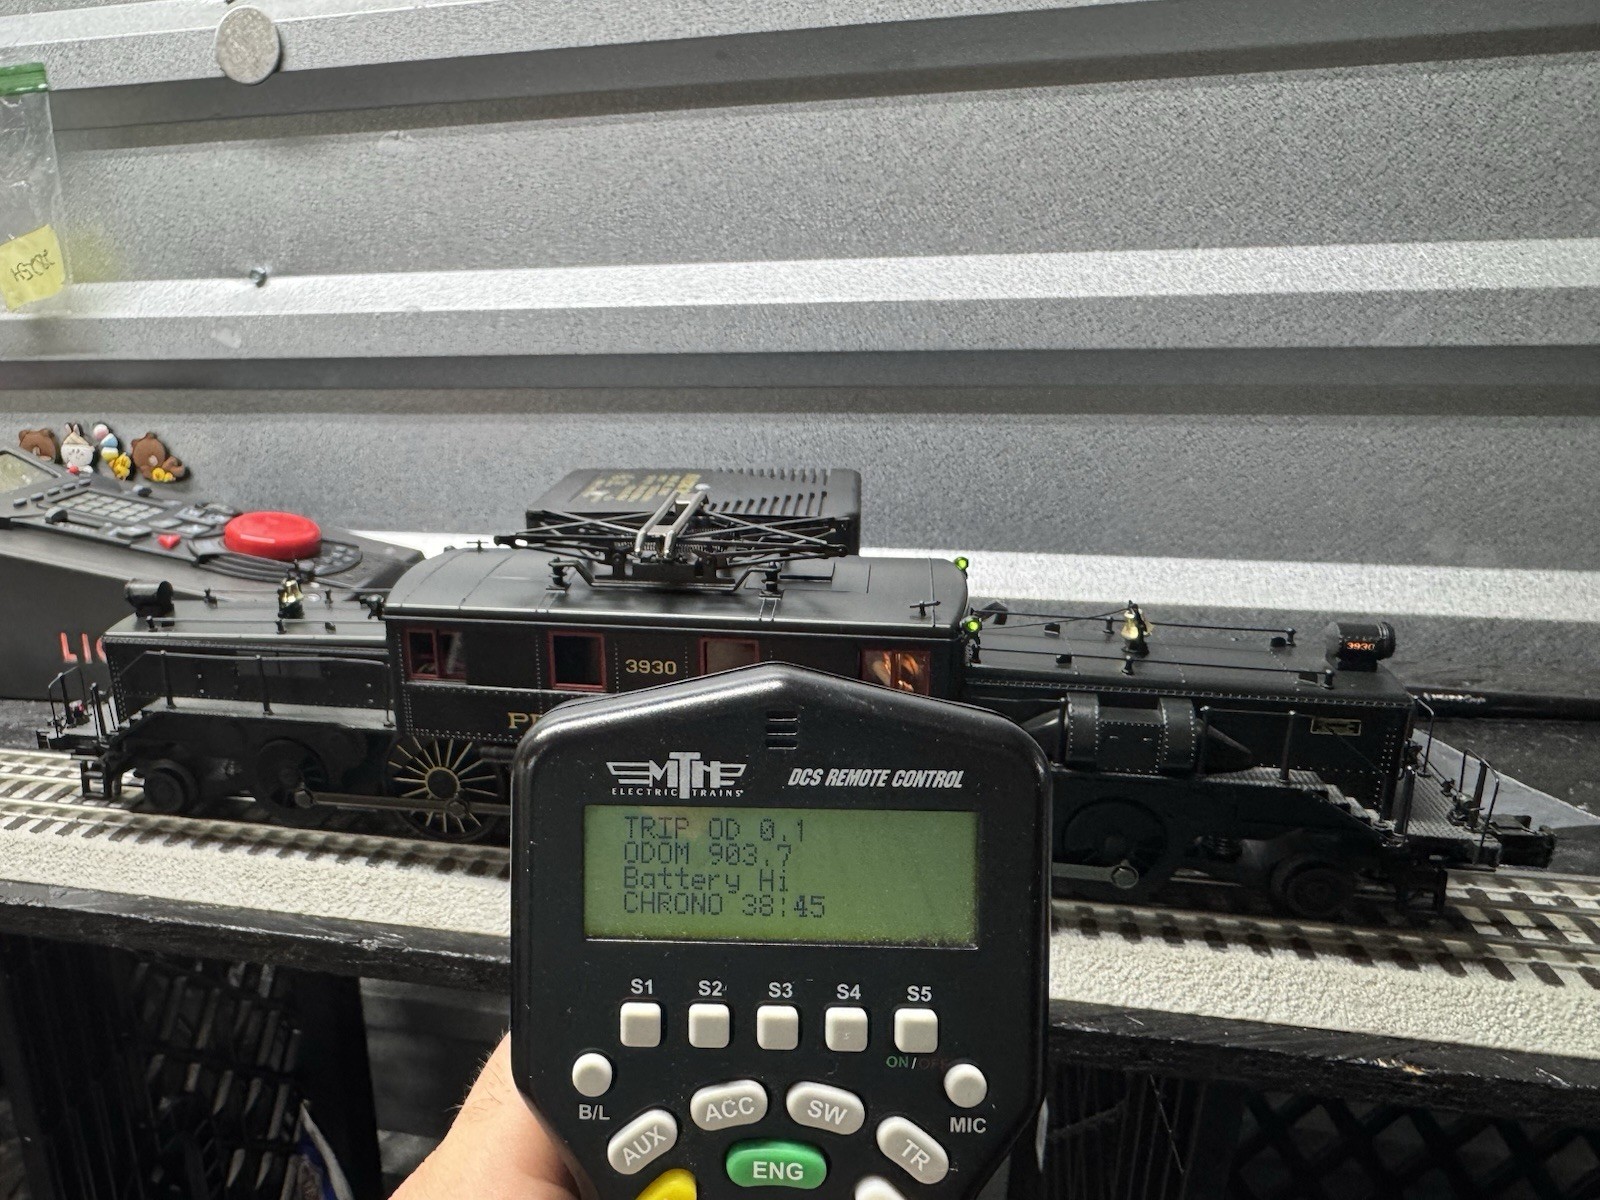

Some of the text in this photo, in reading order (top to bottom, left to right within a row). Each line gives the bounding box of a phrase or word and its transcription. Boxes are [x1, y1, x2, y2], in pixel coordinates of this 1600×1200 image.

[1346, 641, 1375, 651] 3930
[625, 659, 677, 675] 3930
[649, 751, 721, 799] MTH
[788, 768, 964, 788] DCS REMOTE CONTROL
[611, 787, 678, 797] ELECTRIC
[624, 816, 804, 842] TRIP OD 0.1
[624, 841, 792, 867] ODOM 903.7
[624, 866, 789, 894] Battery Hi
[624, 891, 826, 918] CHRONO 38:45
[630, 979, 653, 994] S1
[698, 980, 722, 996] S2
[768, 982, 793, 997] S3
[836, 983, 861, 1000] S4
[907, 986, 932, 1001] S5
[578, 1104, 610, 1120] B/L
[705, 1096, 755, 1122] ACC
[807, 1099, 848, 1126] SW
[950, 1117, 987, 1134] MIC
[621, 1125, 667, 1167] AUX
[899, 1138, 931, 1172] TR
[752, 1160, 804, 1181] ENG
